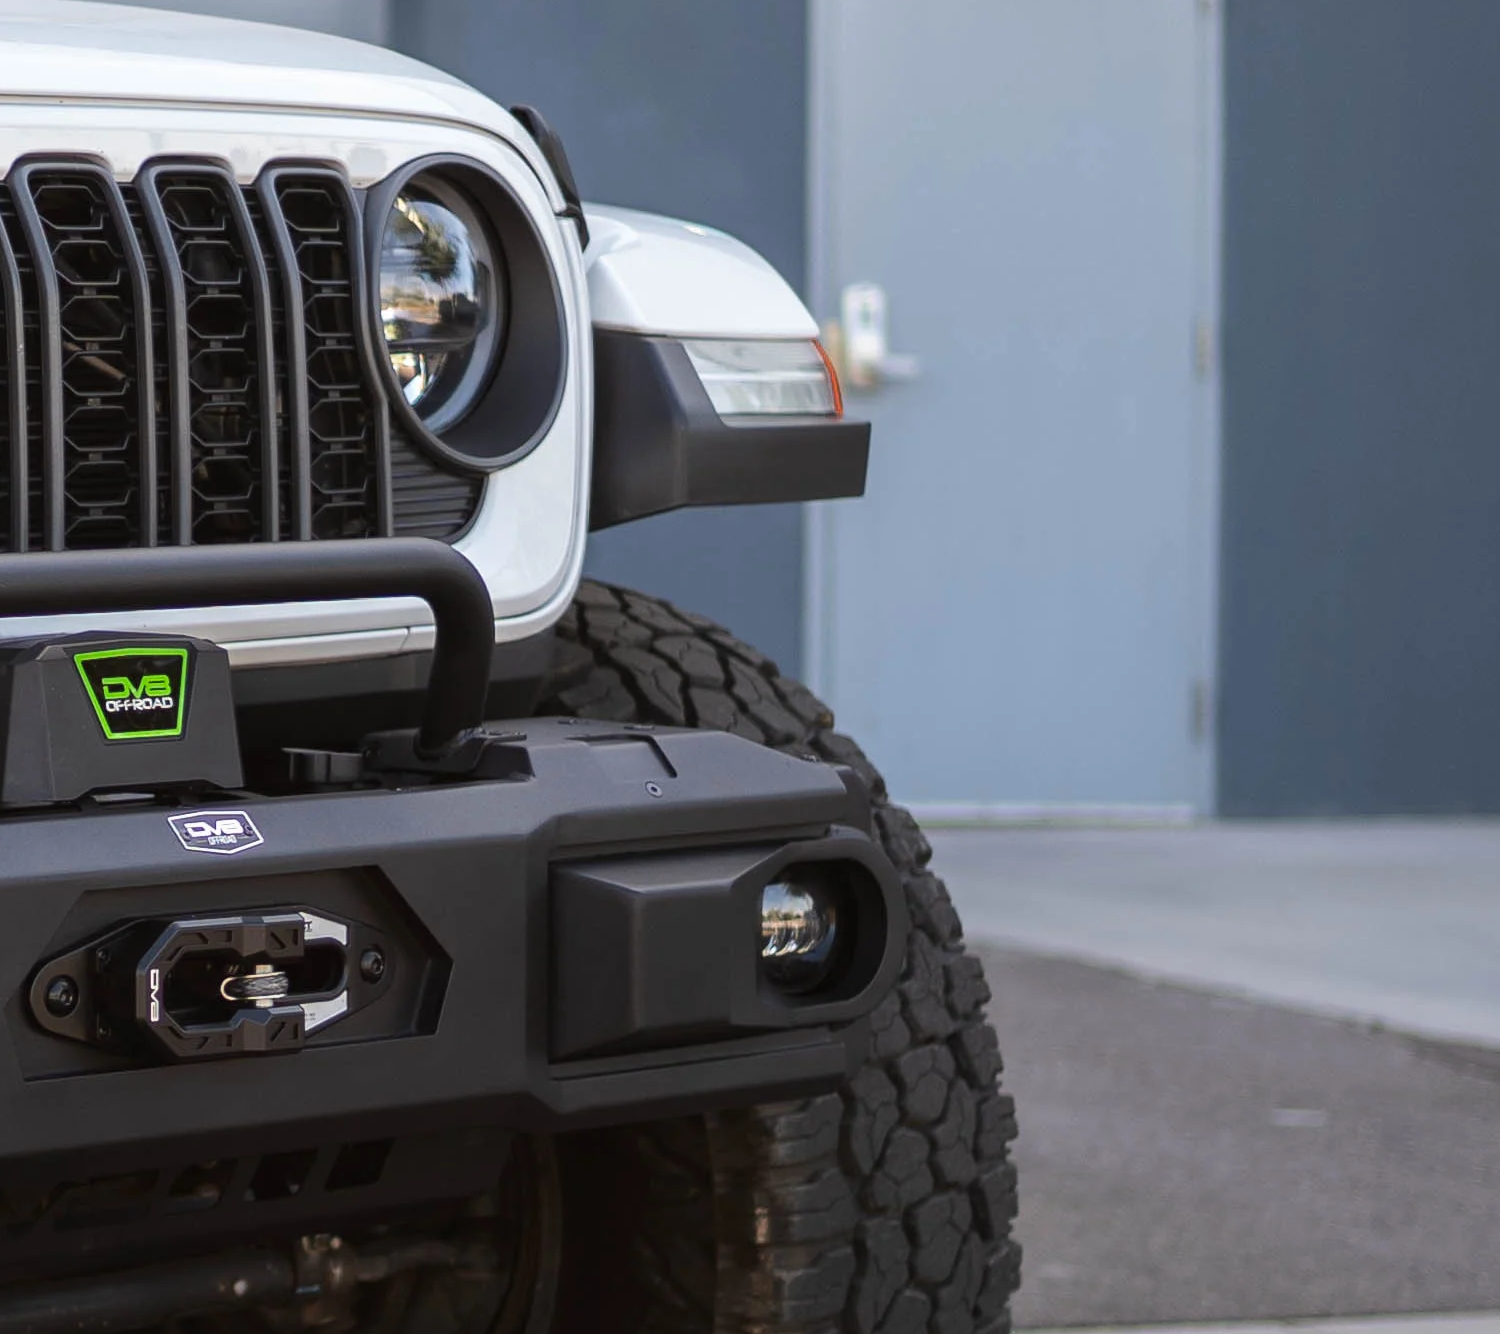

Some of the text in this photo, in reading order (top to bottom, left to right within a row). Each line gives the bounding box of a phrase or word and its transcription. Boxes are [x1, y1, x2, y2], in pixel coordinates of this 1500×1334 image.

[102, 674, 172, 699] DV8
[105, 696, 174, 713] OFFROAD
[183, 818, 244, 838] DV8
